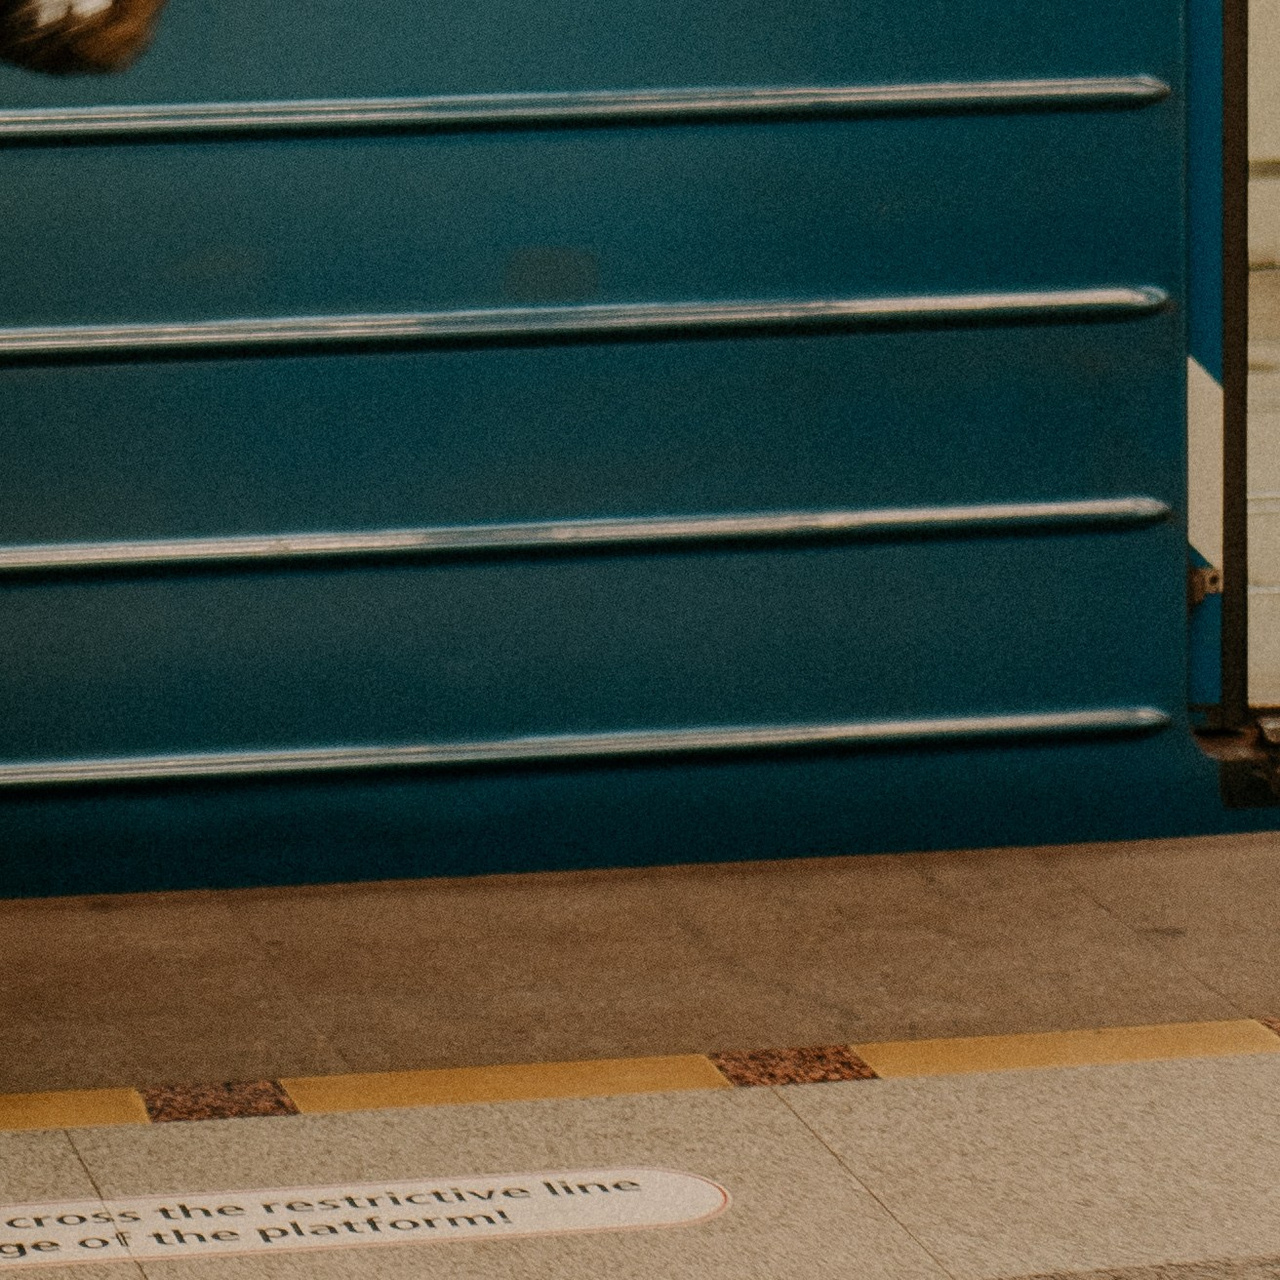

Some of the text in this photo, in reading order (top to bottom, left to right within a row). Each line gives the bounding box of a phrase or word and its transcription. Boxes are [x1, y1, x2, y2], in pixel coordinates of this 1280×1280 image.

[5, 1210, 141, 1230] cross
[154, 1202, 246, 1221] the
[262, 1186, 532, 1215] restrictive
[542, 1178, 643, 1197] line
[78, 1231, 132, 1249] of
[148, 1228, 244, 1246] the
[256, 1208, 514, 1244] platform!
